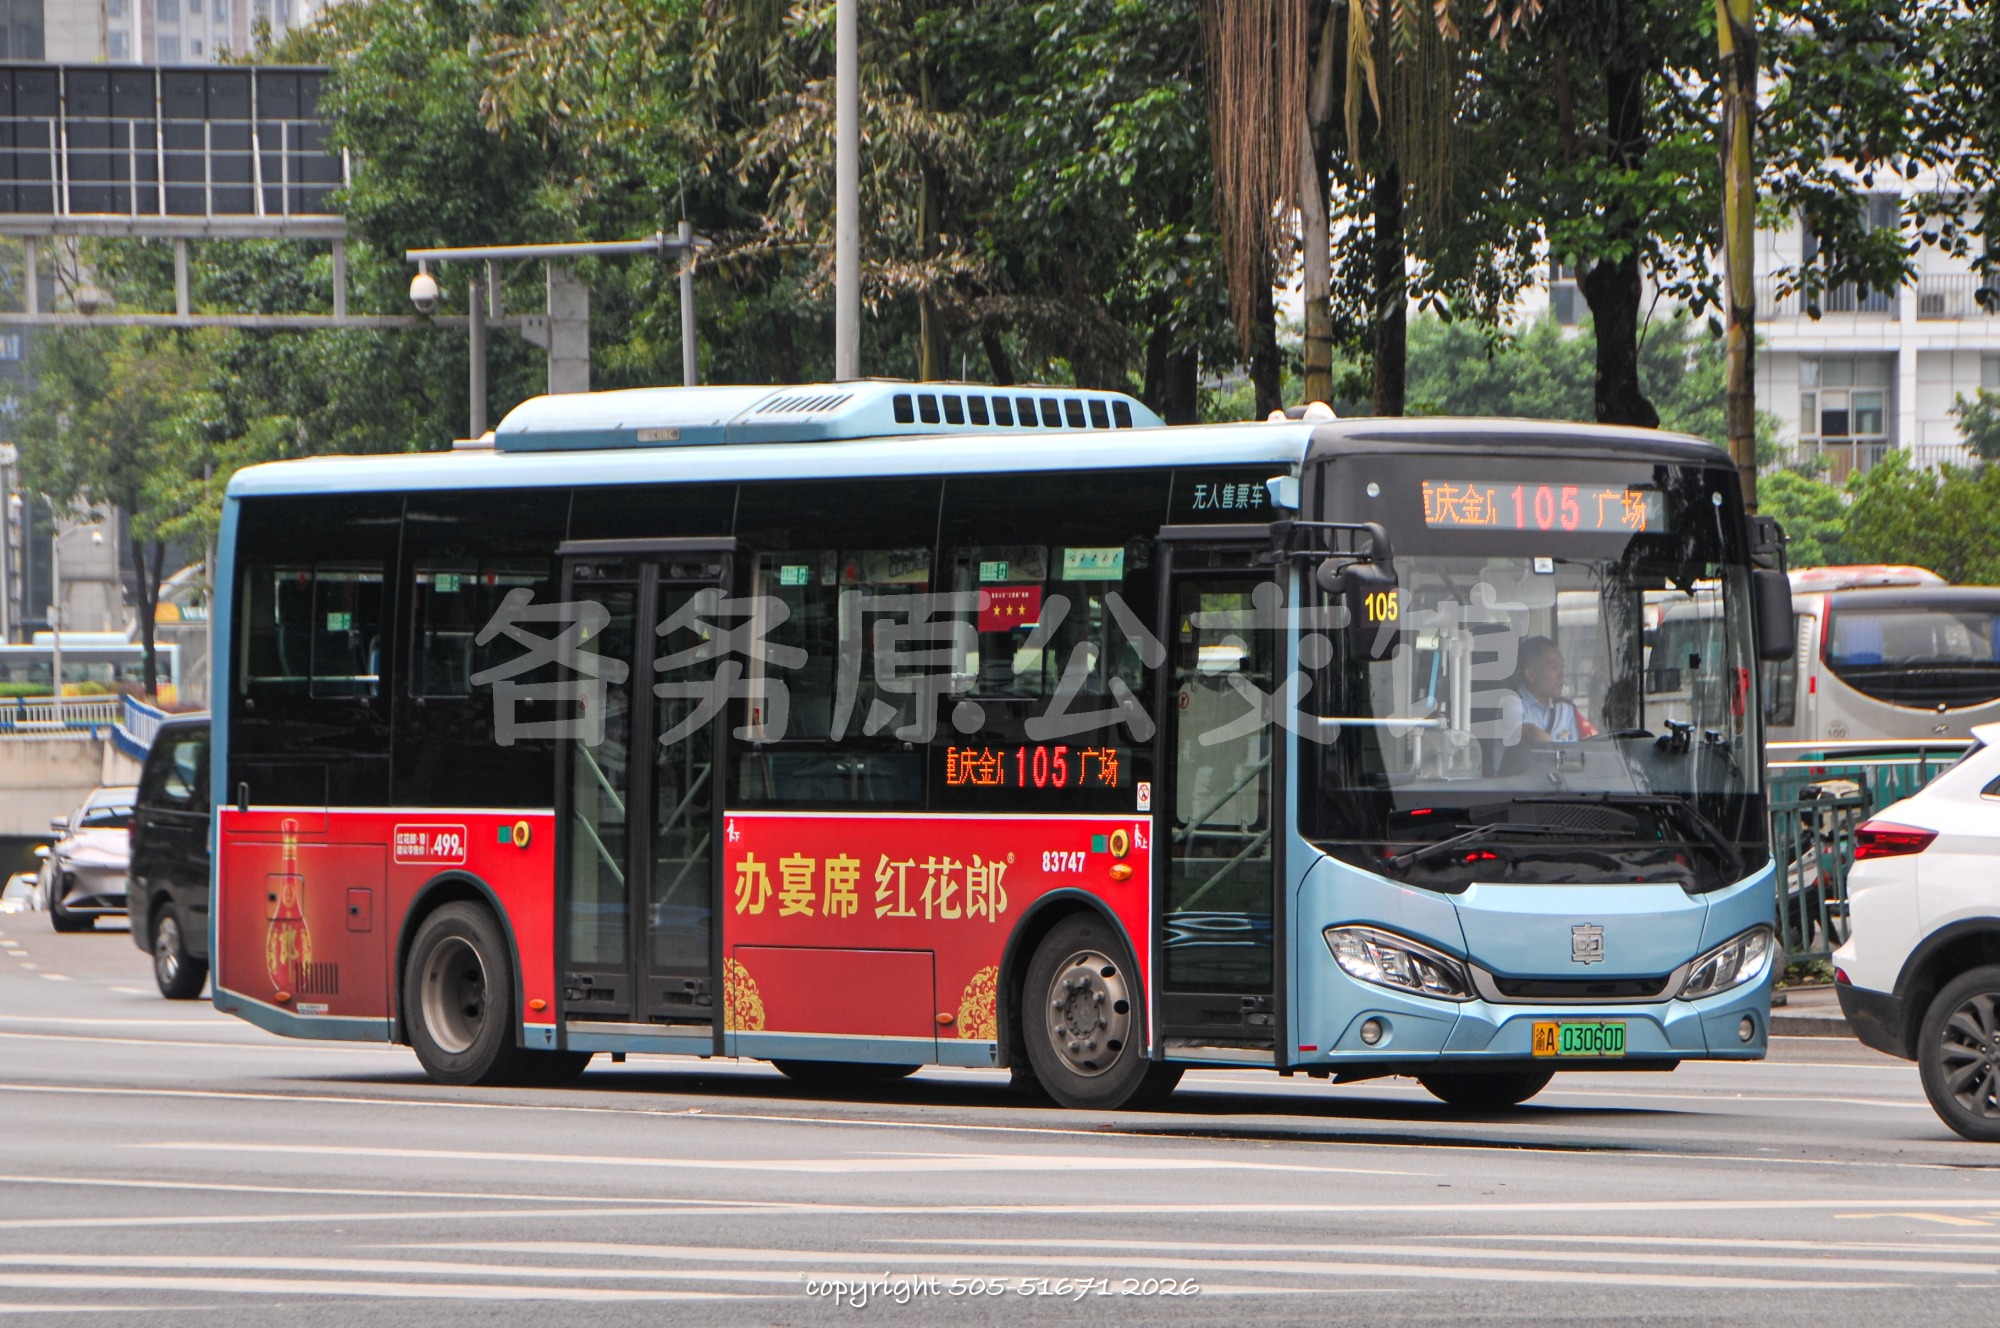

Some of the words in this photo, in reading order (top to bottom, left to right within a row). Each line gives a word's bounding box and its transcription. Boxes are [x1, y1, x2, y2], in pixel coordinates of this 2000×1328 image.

[1192, 483, 1265, 509] 无人售票车
[1512, 485, 1580, 531] 105
[1365, 592, 1398, 621] 105
[1016, 746, 1069, 788] 105
[733, 831, 741, 842] 下
[1140, 838, 1148, 849] 上
[1042, 851, 1086, 872] 83747
[734, 852, 861, 918] 办宴席
[874, 853, 1008, 923] 红花郎
